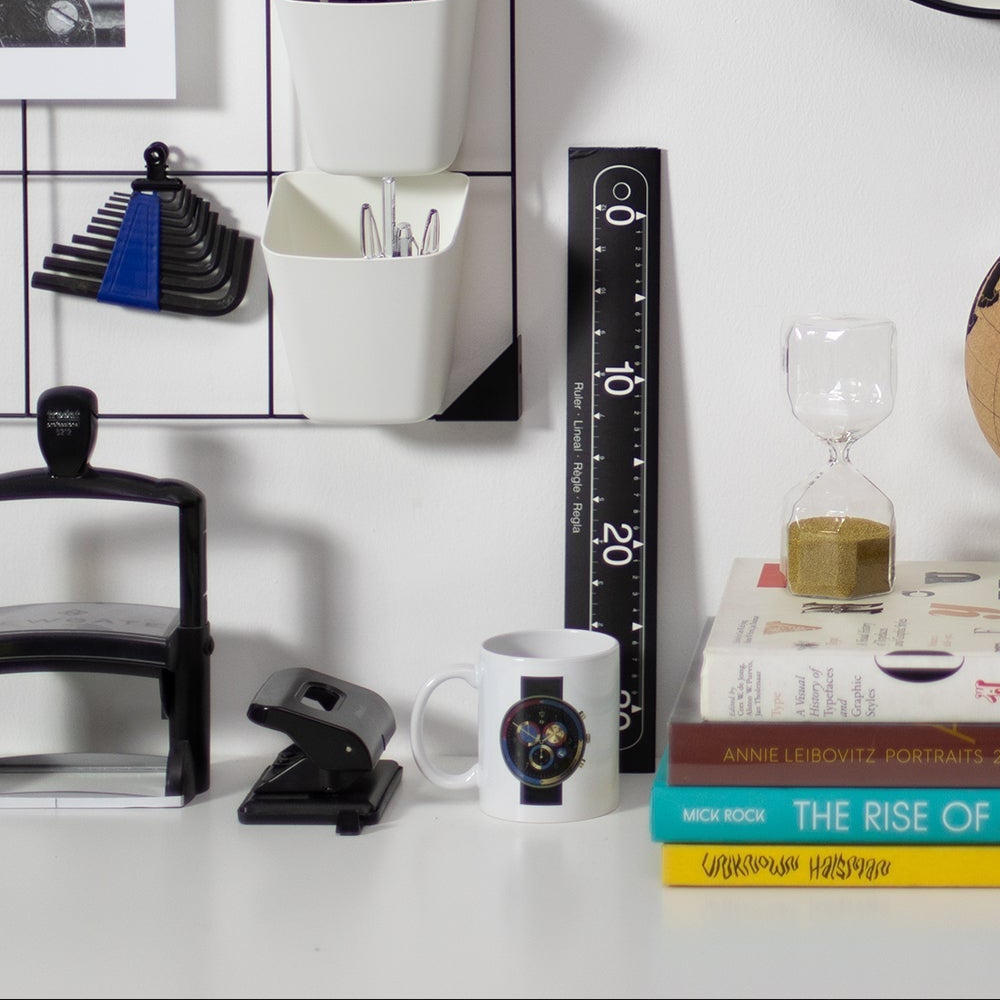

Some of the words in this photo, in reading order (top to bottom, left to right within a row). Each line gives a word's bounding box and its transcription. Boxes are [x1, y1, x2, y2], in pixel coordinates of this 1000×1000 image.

[605, 205, 635, 226] 0
[604, 361, 634, 396] 10
[573, 381, 584, 409] Ruler
[573, 420, 584, 452] Lineal
[570, 461, 583, 493] Règle
[570, 502, 583, 534] Regla
[602, 522, 633, 566] 20
[809, 666, 822, 679] of
[771, 691, 786, 717] Type
[795, 675, 806, 706] Visual
[810, 681, 824, 717] History
[823, 667, 838, 717] Typefaces
[851, 675, 865, 717] Graphic
[865, 688, 880, 717] Styles
[837, 699, 848, 717] and
[723, 748, 779, 763] ANNIE
[785, 748, 876, 763] LEIBOVITZ
[886, 748, 984, 764] PORTRAITS
[682, 809, 720, 822] MICK
[724, 809, 766, 823] ROCK
[793, 800, 849, 831] THE
[865, 801, 928, 832] RISE
[942, 801, 990, 832] OF
